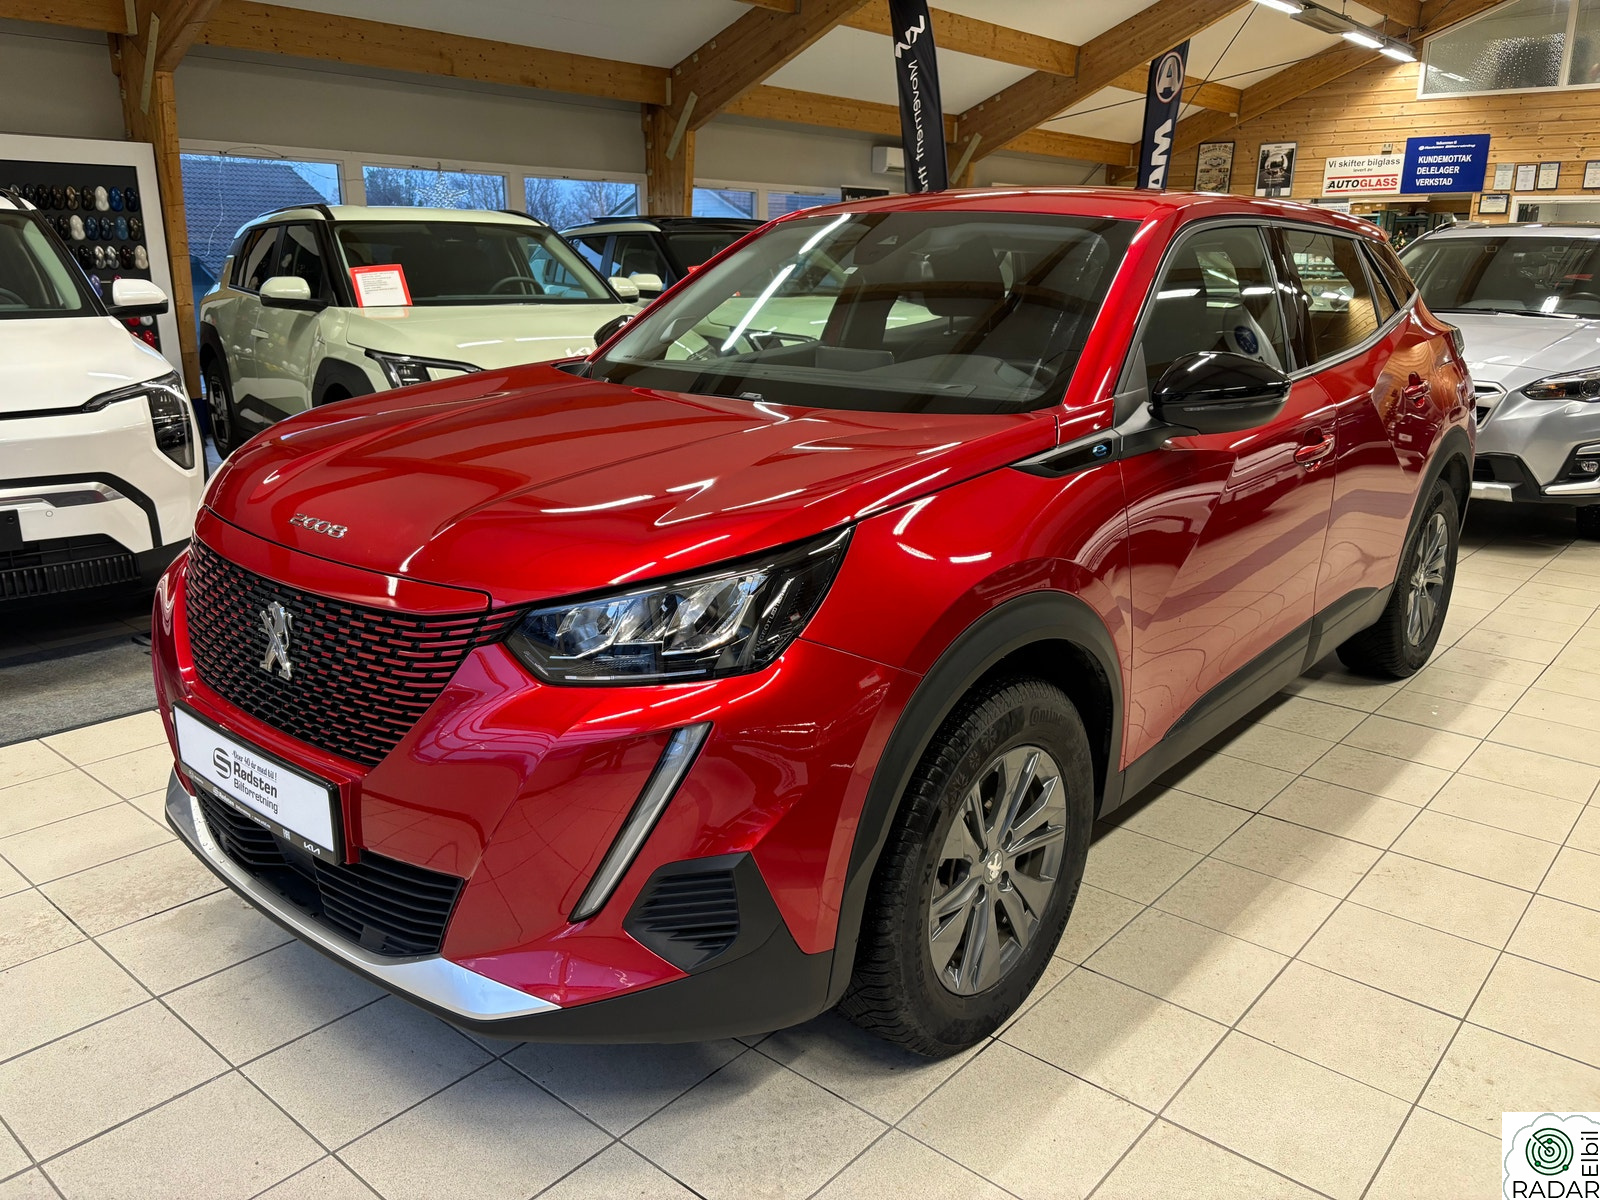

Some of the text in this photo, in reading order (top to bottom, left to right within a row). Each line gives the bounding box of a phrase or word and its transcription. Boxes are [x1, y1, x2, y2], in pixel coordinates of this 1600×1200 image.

[1339, 160, 1366, 168] skifter
[1367, 158, 1401, 167] bilglass
[1418, 154, 1472, 164] KUNDEMOTTAK
[1416, 166, 1460, 175] DELELAGER
[1327, 178, 1398, 189] AUTOGLASS
[1415, 177, 1453, 186] VERKSTAD
[289, 513, 348, 538] 2008
[234, 761, 277, 798] Rødsten
[234, 778, 278, 815] Bilforretning
